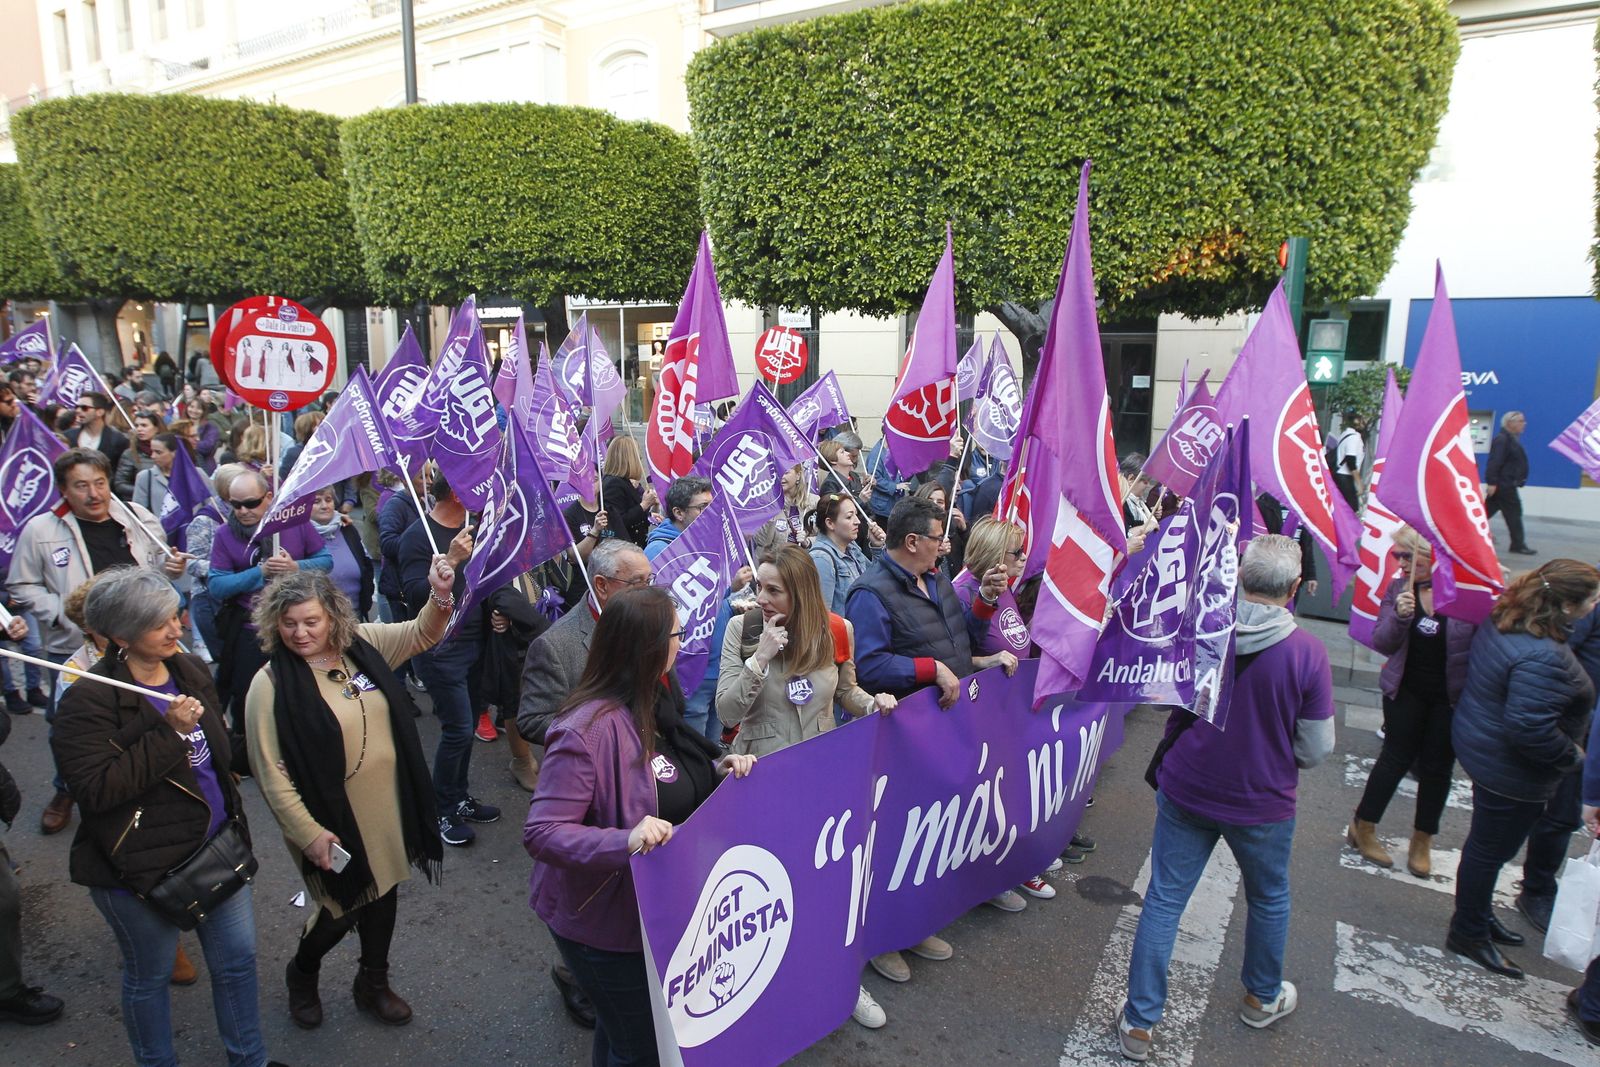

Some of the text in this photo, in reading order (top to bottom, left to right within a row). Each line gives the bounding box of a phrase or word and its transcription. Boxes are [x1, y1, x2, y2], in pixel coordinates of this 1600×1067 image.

[763, 329, 803, 357] UGT
[450, 366, 497, 438] UGT
[1461, 371, 1499, 385] BVA
[348, 384, 385, 454] www.ugt.es
[757, 395, 804, 448] www.ugt.es
[715, 434, 773, 496] UGT
[788, 678, 810, 697] UGT
[1027, 704, 1067, 833] ni
[708, 885, 743, 936] UGT
[667, 898, 788, 1008] FEMINISTA
